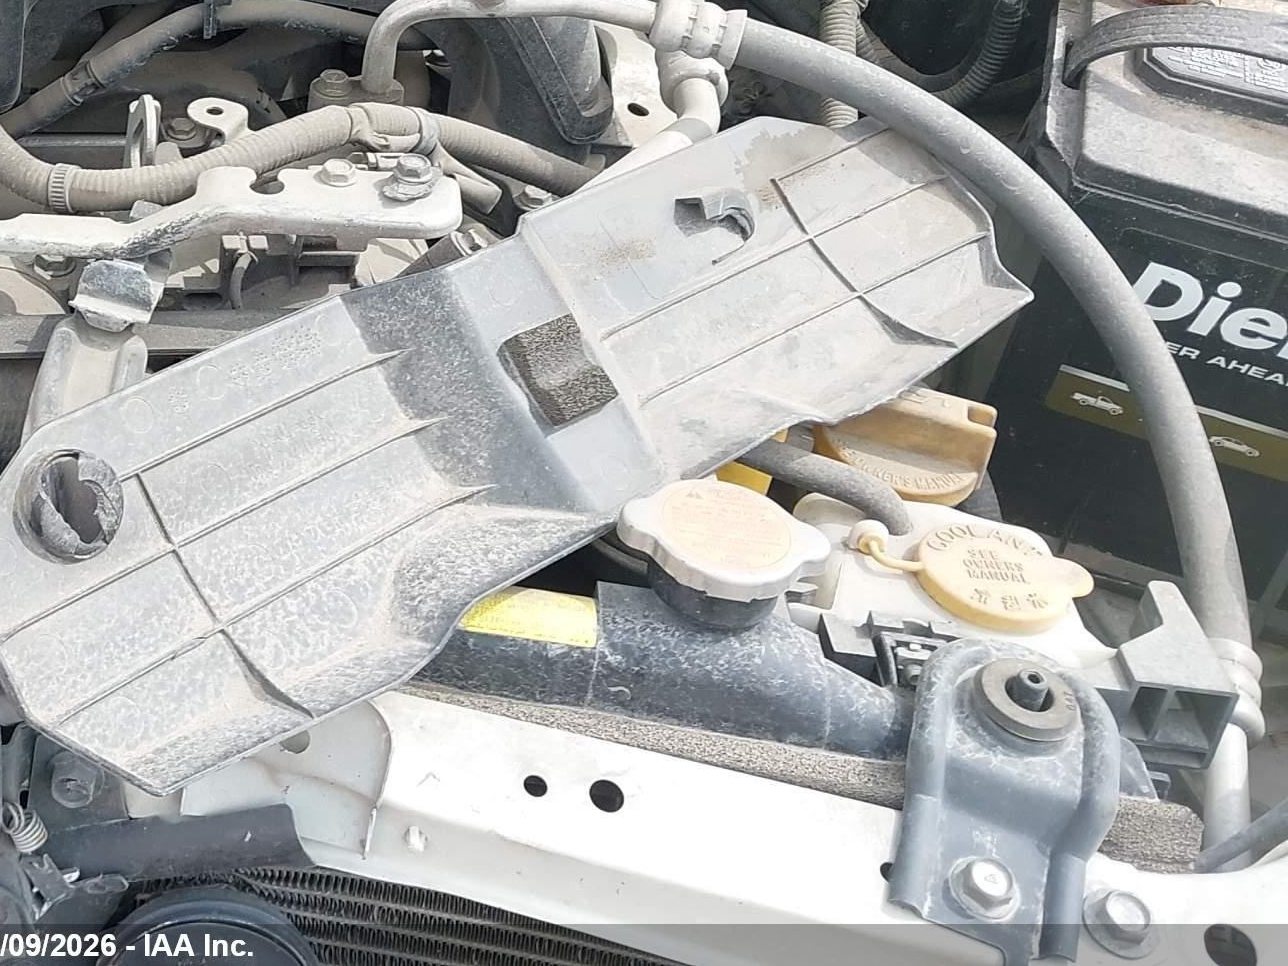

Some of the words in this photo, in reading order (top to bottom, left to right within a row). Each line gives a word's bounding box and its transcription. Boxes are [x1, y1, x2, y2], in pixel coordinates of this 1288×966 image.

[1132, 261, 1288, 360] Die
[1206, 355, 1288, 387] AHEA
[926, 524, 1043, 556] COOLANT
[966, 569, 1031, 585] MANUAL
